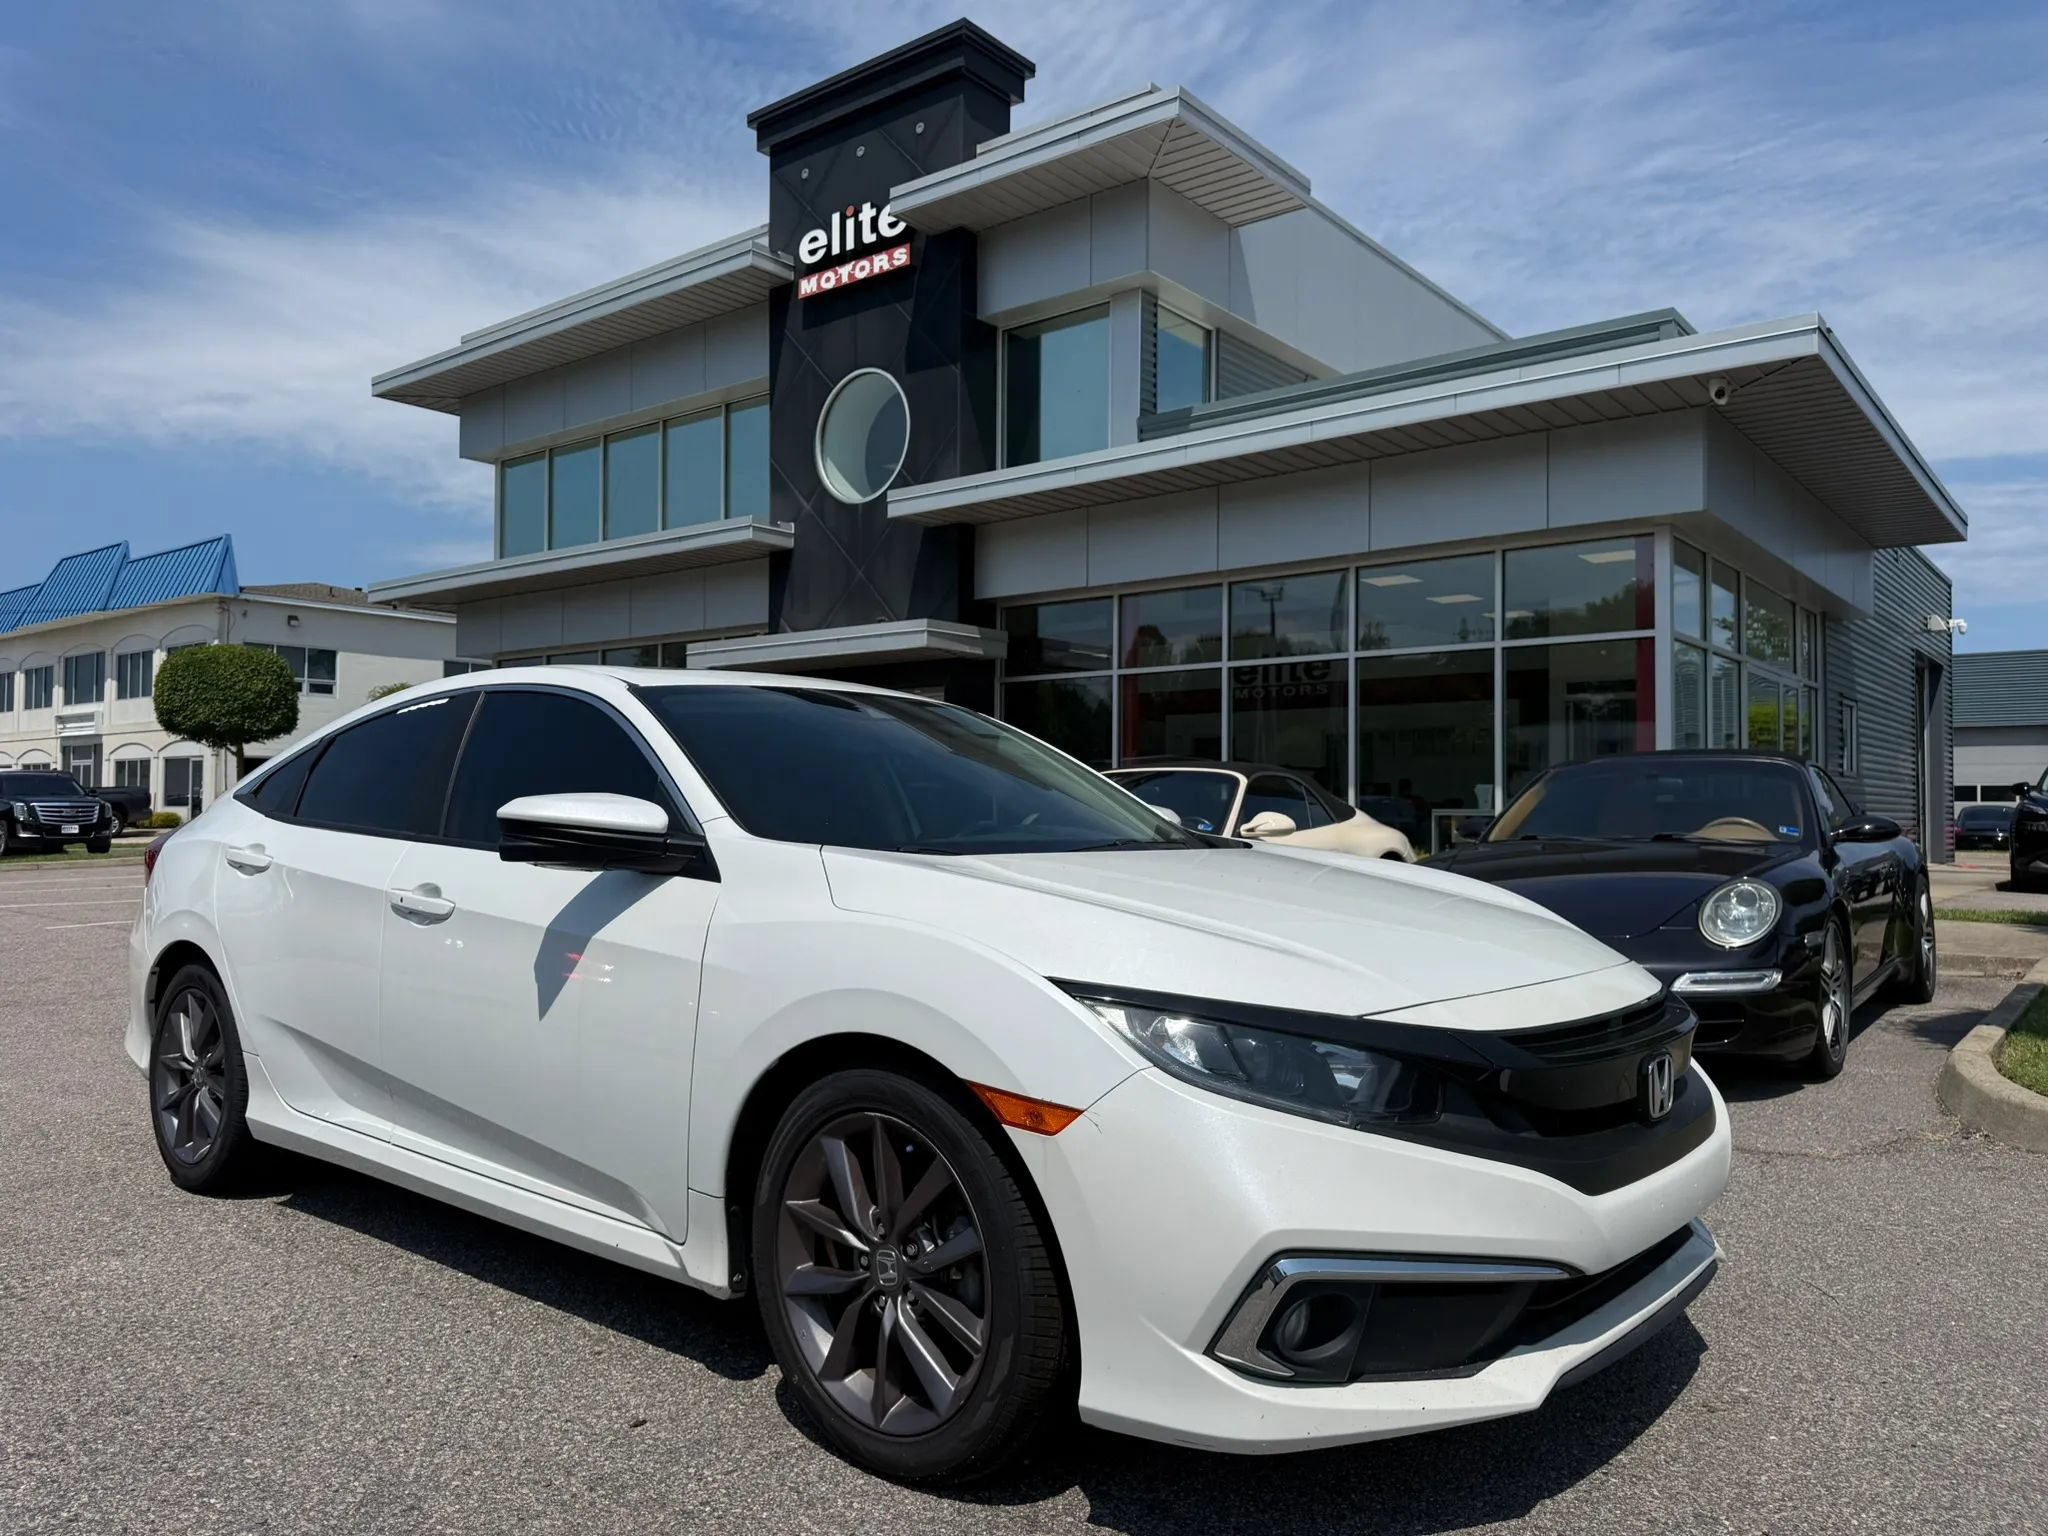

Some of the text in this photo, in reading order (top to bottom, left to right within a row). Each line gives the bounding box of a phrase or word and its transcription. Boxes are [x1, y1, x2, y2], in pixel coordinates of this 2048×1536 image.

[799, 201, 907, 264] elite
[801, 247, 907, 294] MOTORS
[1233, 651, 1330, 685] elite
[1235, 683, 1328, 699] MOTORS
